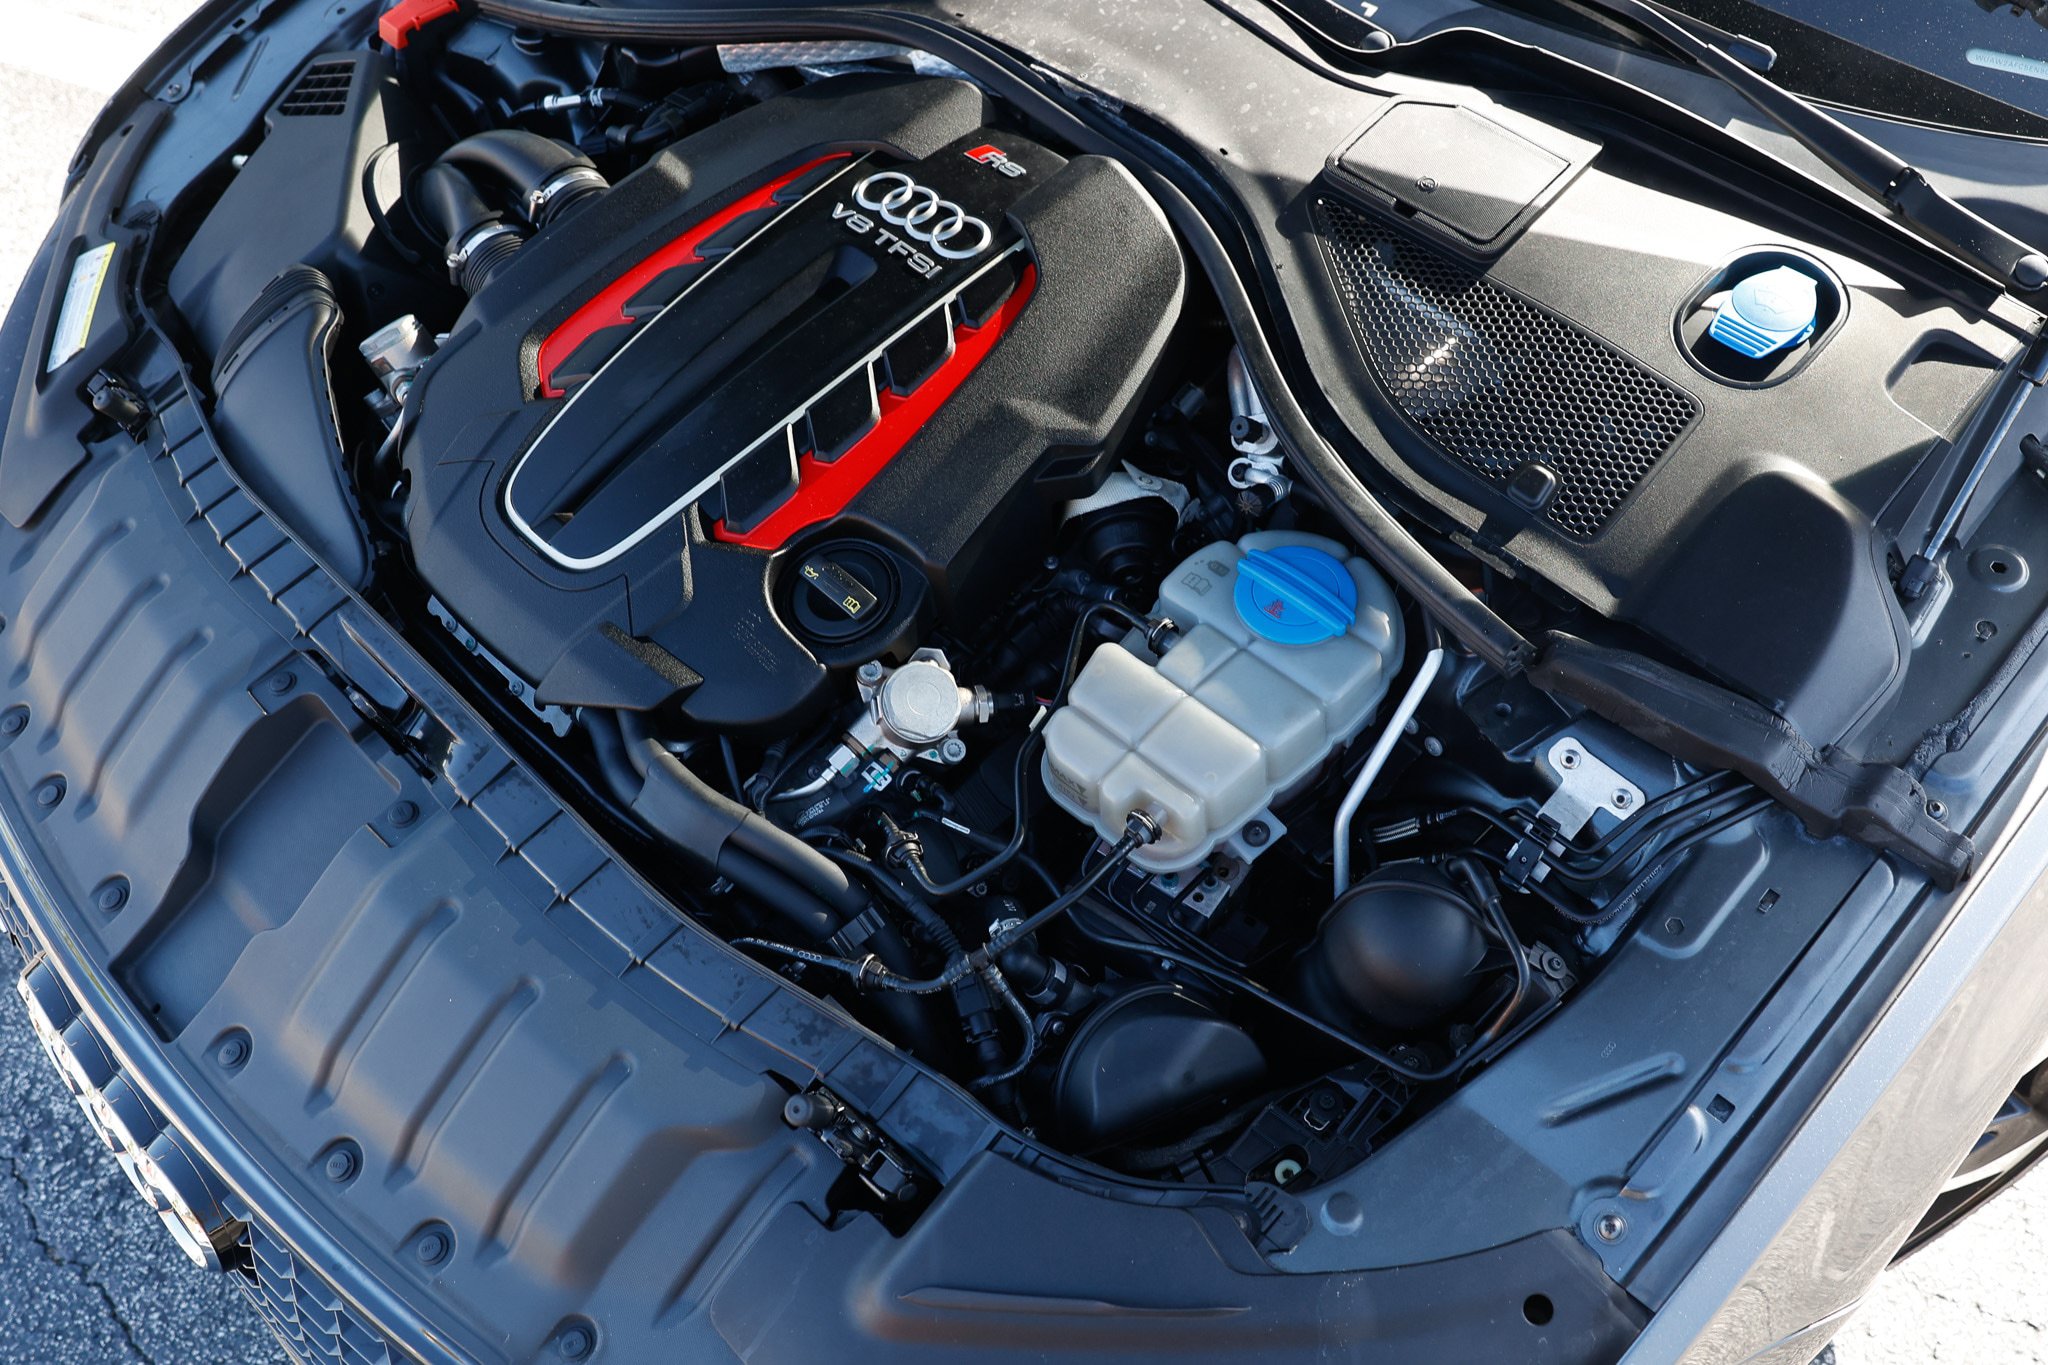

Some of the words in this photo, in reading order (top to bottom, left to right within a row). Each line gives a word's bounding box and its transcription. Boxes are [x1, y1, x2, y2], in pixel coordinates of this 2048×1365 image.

[976, 150, 1027, 178] RS
[831, 201, 875, 234] V8
[874, 227, 943, 280] TFSI
